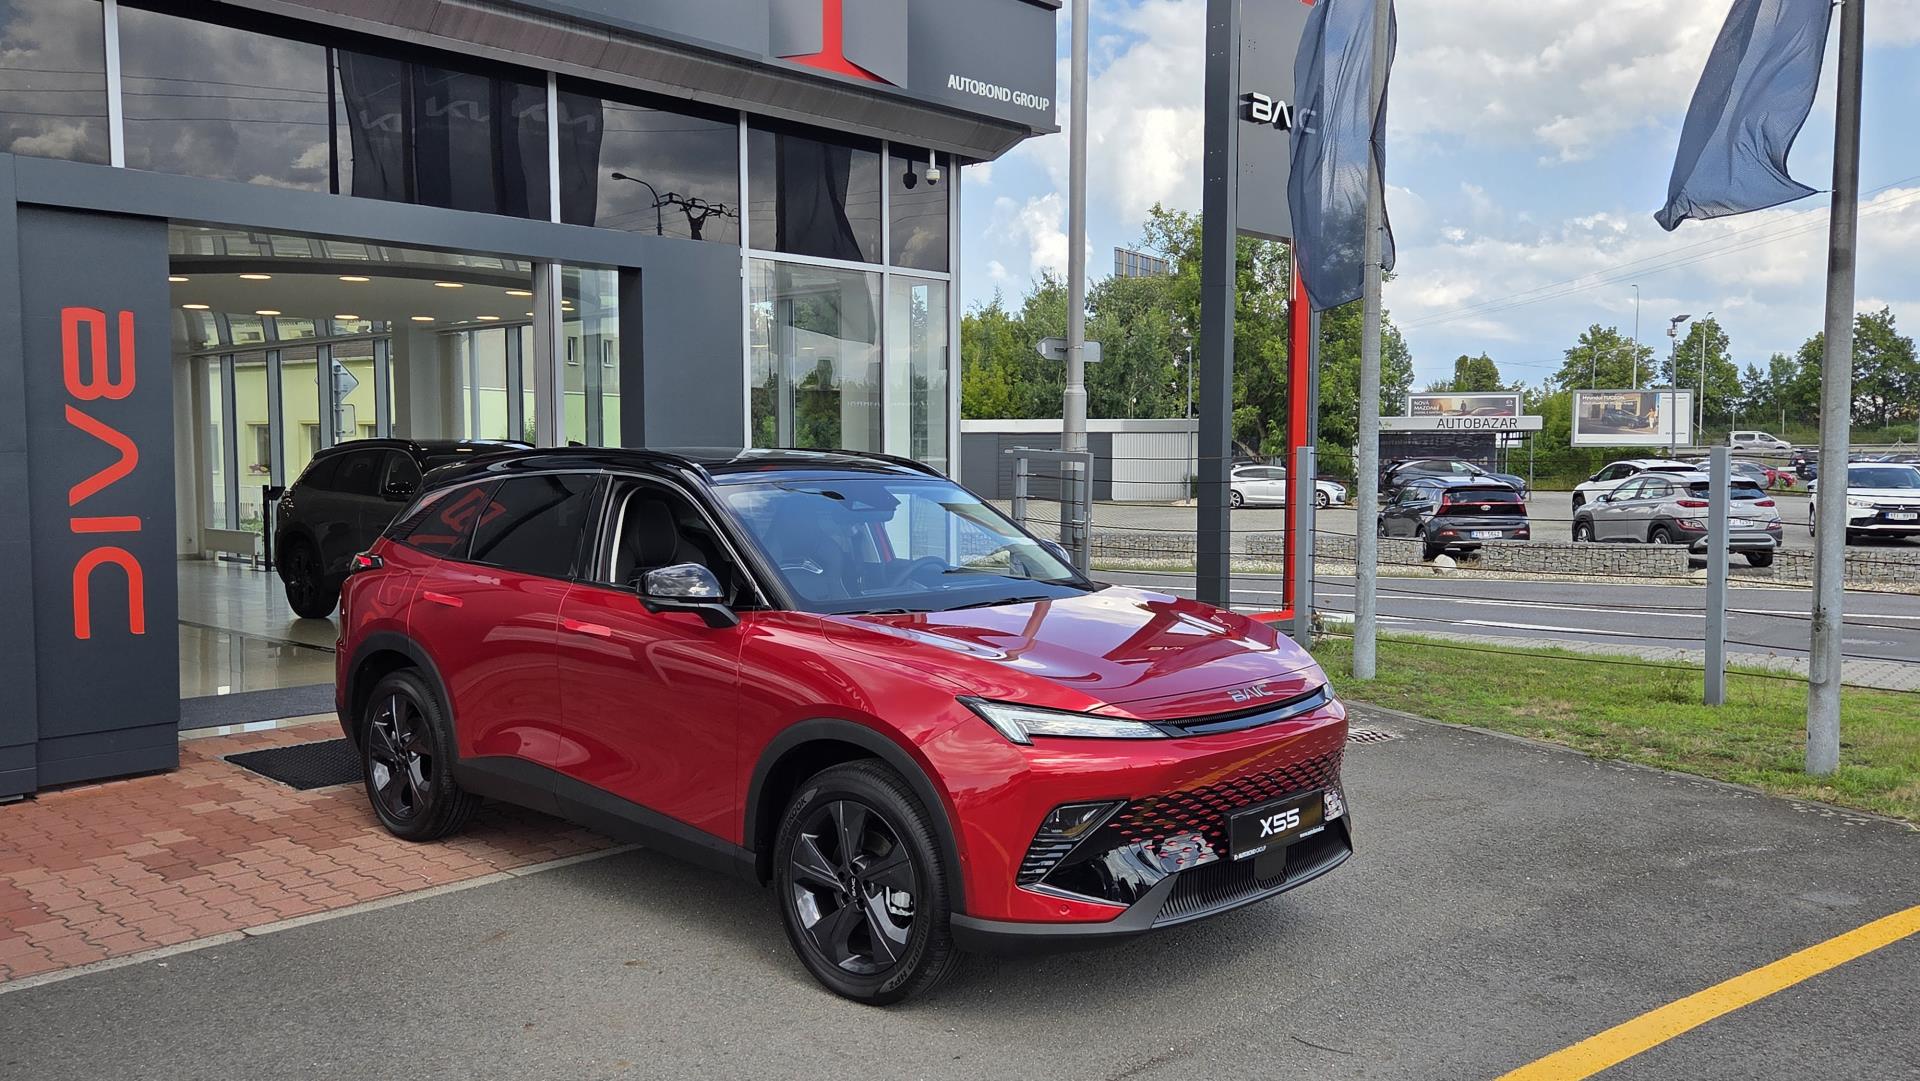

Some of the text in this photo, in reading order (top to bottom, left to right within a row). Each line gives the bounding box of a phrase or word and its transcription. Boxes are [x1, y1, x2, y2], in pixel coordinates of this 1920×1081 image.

[947, 74, 1050, 111] AUTOBOND GROUP
[1436, 418, 1518, 429] AUTOBAZAR
[61, 307, 145, 639] BAIC
[1226, 683, 1275, 703] BAIC
[1259, 807, 1301, 838] X55
